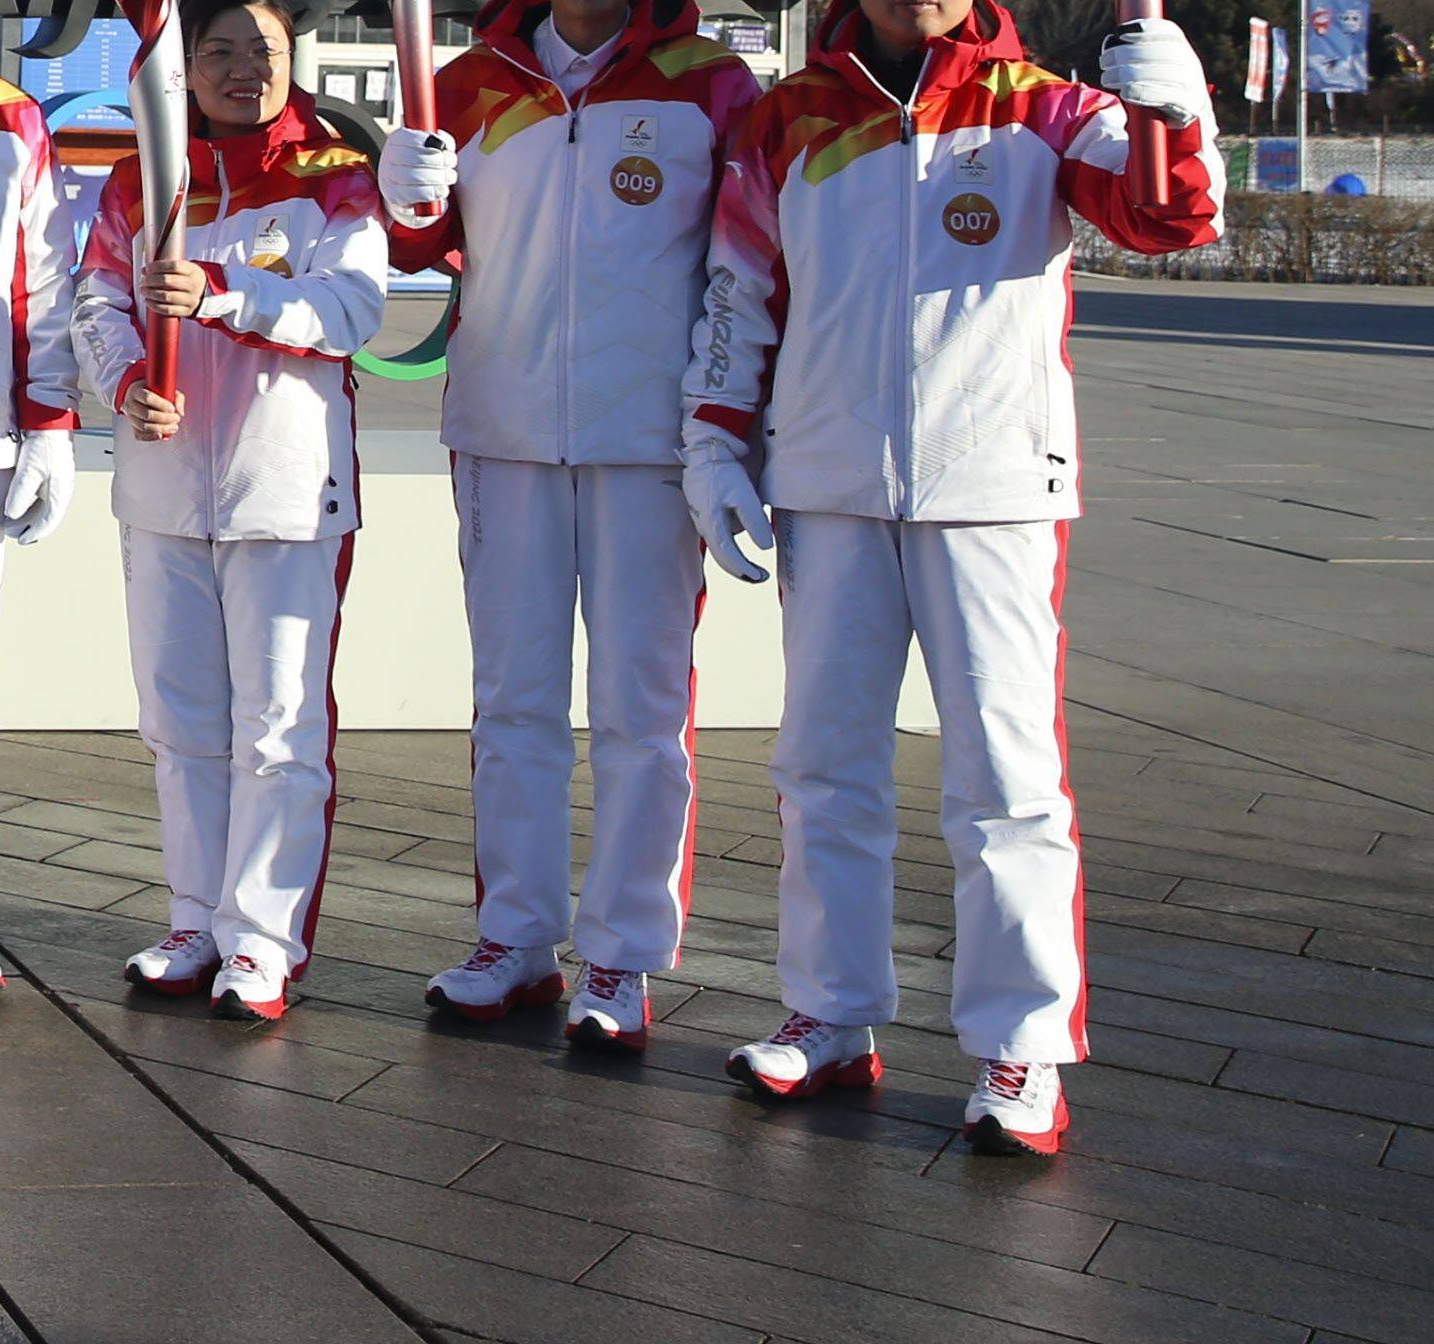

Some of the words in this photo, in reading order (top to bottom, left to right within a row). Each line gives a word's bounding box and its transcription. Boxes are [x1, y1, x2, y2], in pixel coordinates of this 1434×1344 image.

[615, 172, 656, 193] 009
[950, 212, 992, 230] 007
[471, 506, 482, 544] 2022
